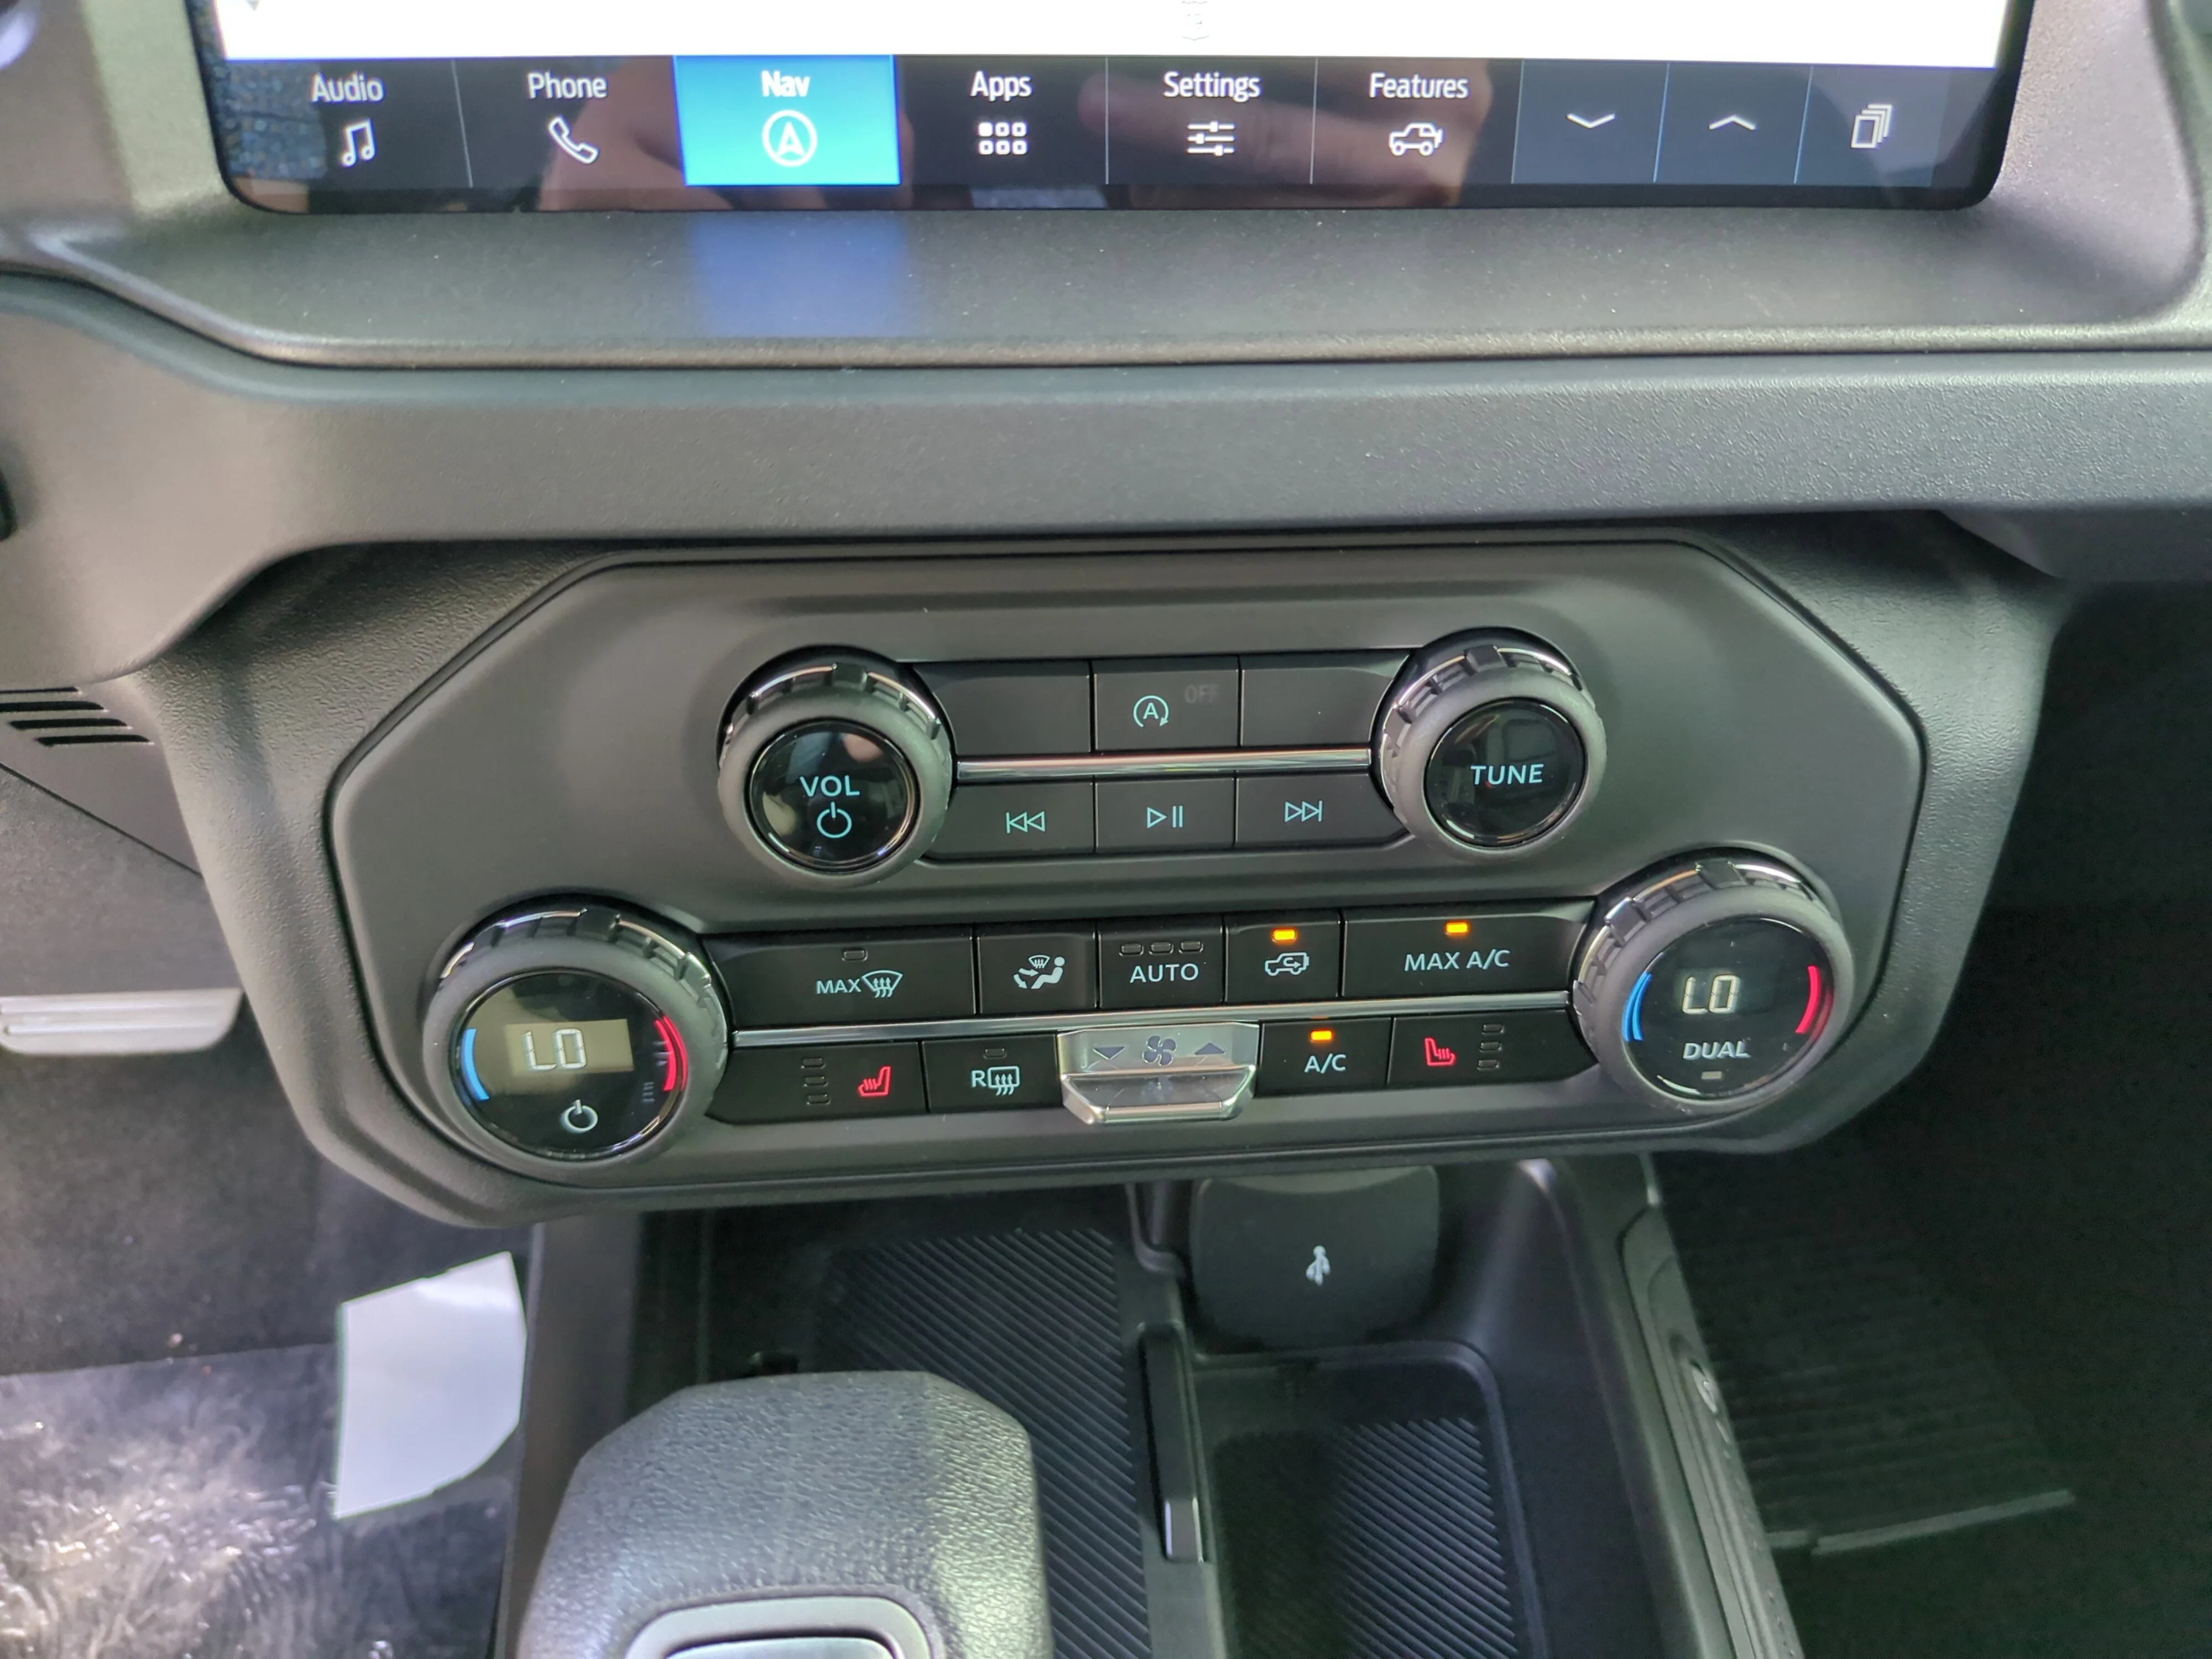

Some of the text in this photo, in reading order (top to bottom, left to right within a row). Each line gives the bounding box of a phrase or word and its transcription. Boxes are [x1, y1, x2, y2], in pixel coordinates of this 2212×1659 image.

[310, 73, 383, 104] Audio
[527, 72, 607, 100] Phone
[760, 70, 811, 97] Nav
[971, 72, 1032, 101] Apps
[1164, 71, 1260, 102] Settings
[1369, 73, 1469, 98] Features
[1183, 684, 1220, 705] OFF
[1144, 702, 1160, 721] A
[1470, 763, 1543, 785] TUNE
[800, 775, 860, 797] VOL
[1404, 949, 1510, 972] MAX A/C
[1129, 963, 1199, 983] AUTO
[816, 978, 862, 995] MAX
[1682, 974, 1740, 1014] LO
[522, 1028, 587, 1071] LO
[1682, 1040, 1751, 1060] DUAL
[1303, 1054, 1347, 1074] A/C
[972, 1070, 986, 1088] R
